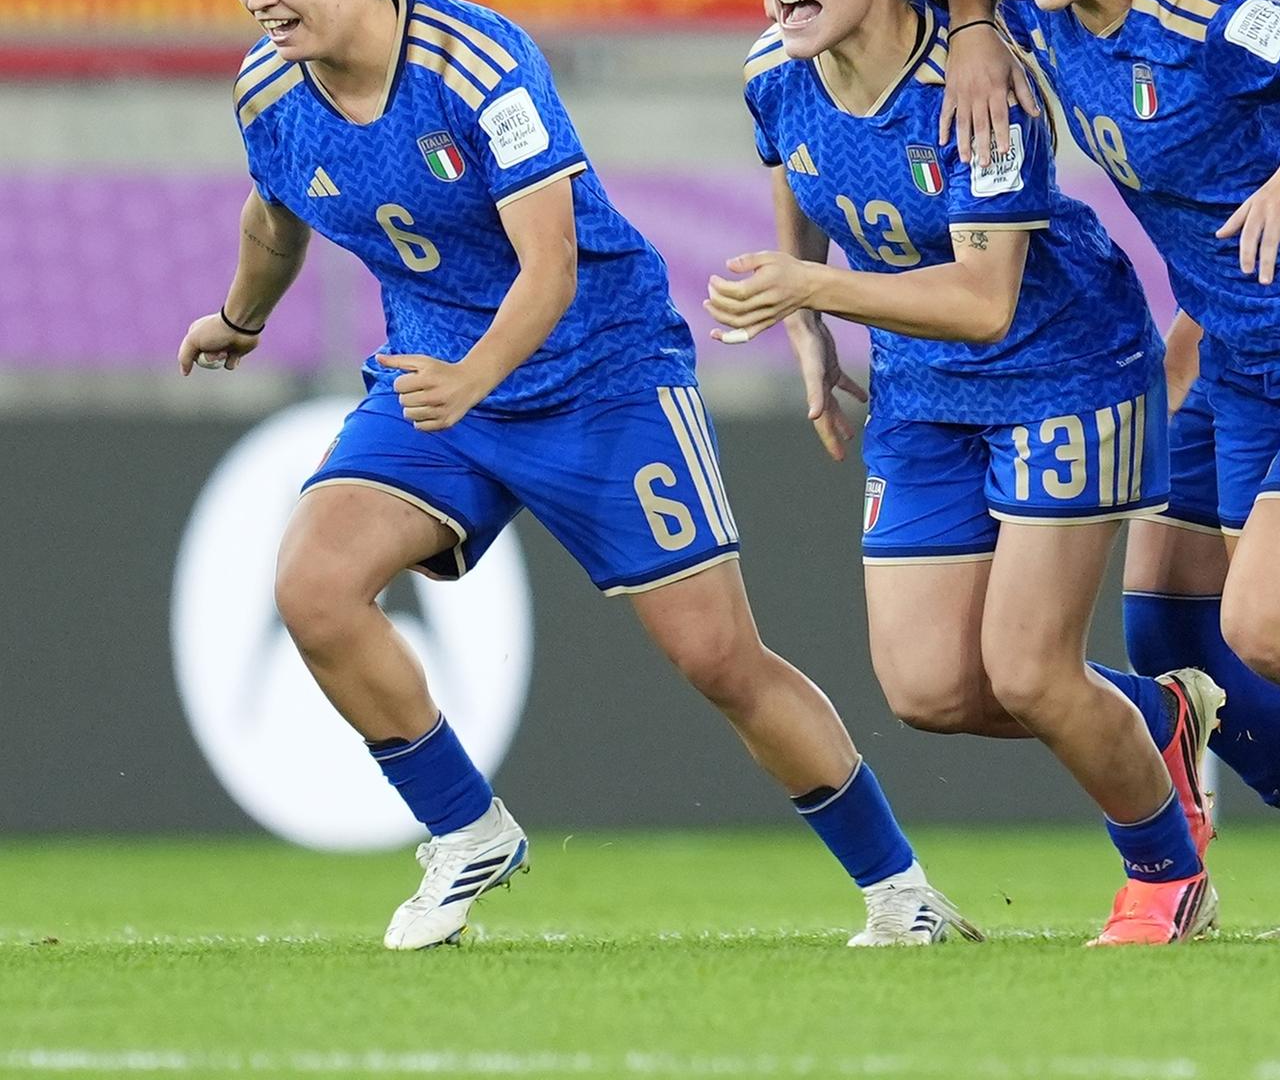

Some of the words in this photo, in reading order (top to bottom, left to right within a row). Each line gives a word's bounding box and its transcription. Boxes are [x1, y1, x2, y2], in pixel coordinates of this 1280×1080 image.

[1238, 3, 1265, 36] FOOTBALL
[1246, 7, 1275, 41] UNITES
[496, 110, 531, 137] UNITES
[420, 133, 451, 151] ITALIA
[990, 147, 1016, 164] NITES
[1074, 105, 1141, 190] 18
[375, 203, 442, 273] 6
[835, 194, 922, 267] 13
[1011, 415, 1087, 501] 13
[633, 462, 697, 552] 6
[1124, 858, 1175, 874] TALIA
